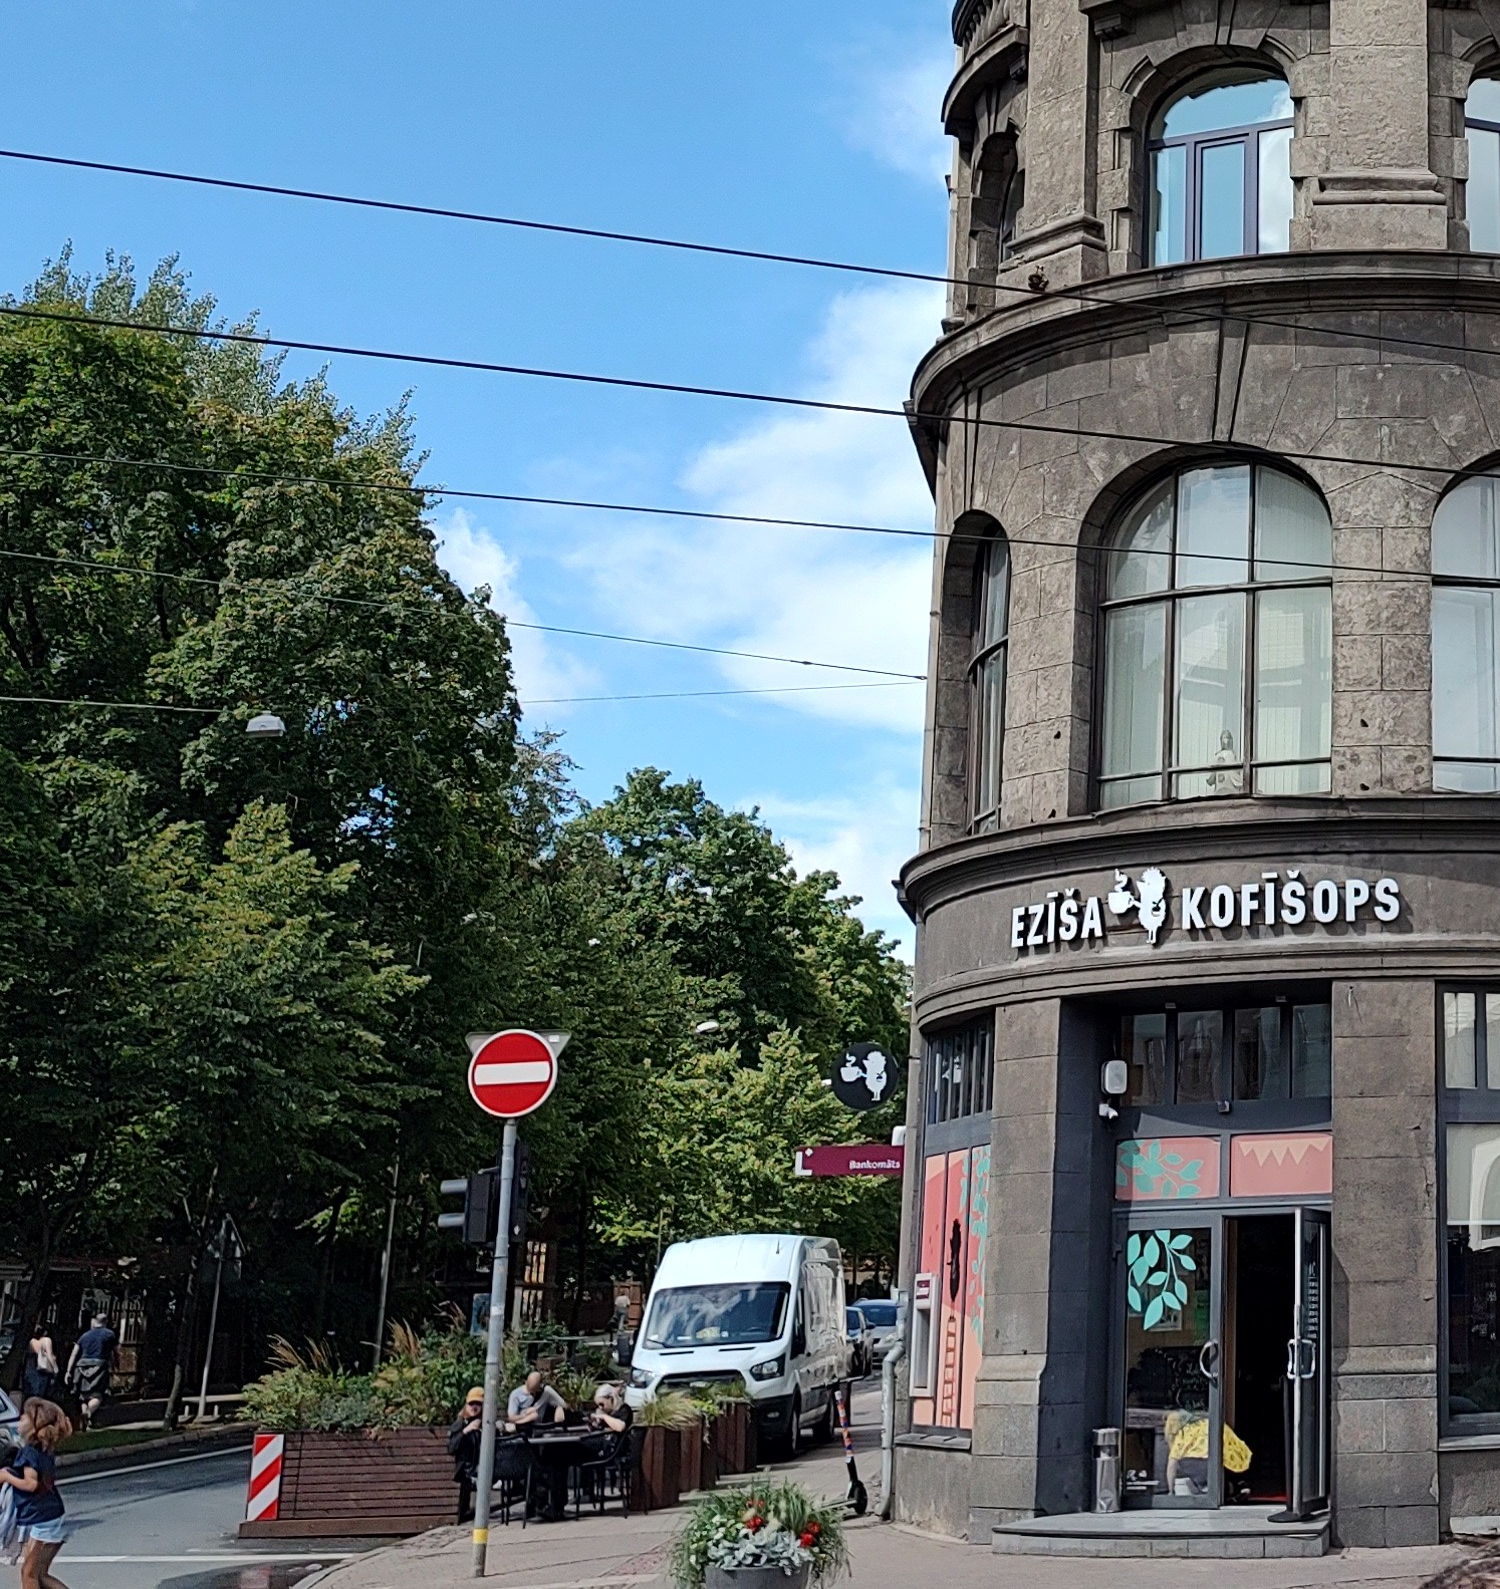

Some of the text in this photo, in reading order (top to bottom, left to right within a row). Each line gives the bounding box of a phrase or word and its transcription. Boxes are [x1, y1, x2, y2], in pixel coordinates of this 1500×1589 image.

[1010, 868, 1401, 949] EZĪŠA KOFĪŠOPS
[849, 1159, 901, 1170] Bankomāts
